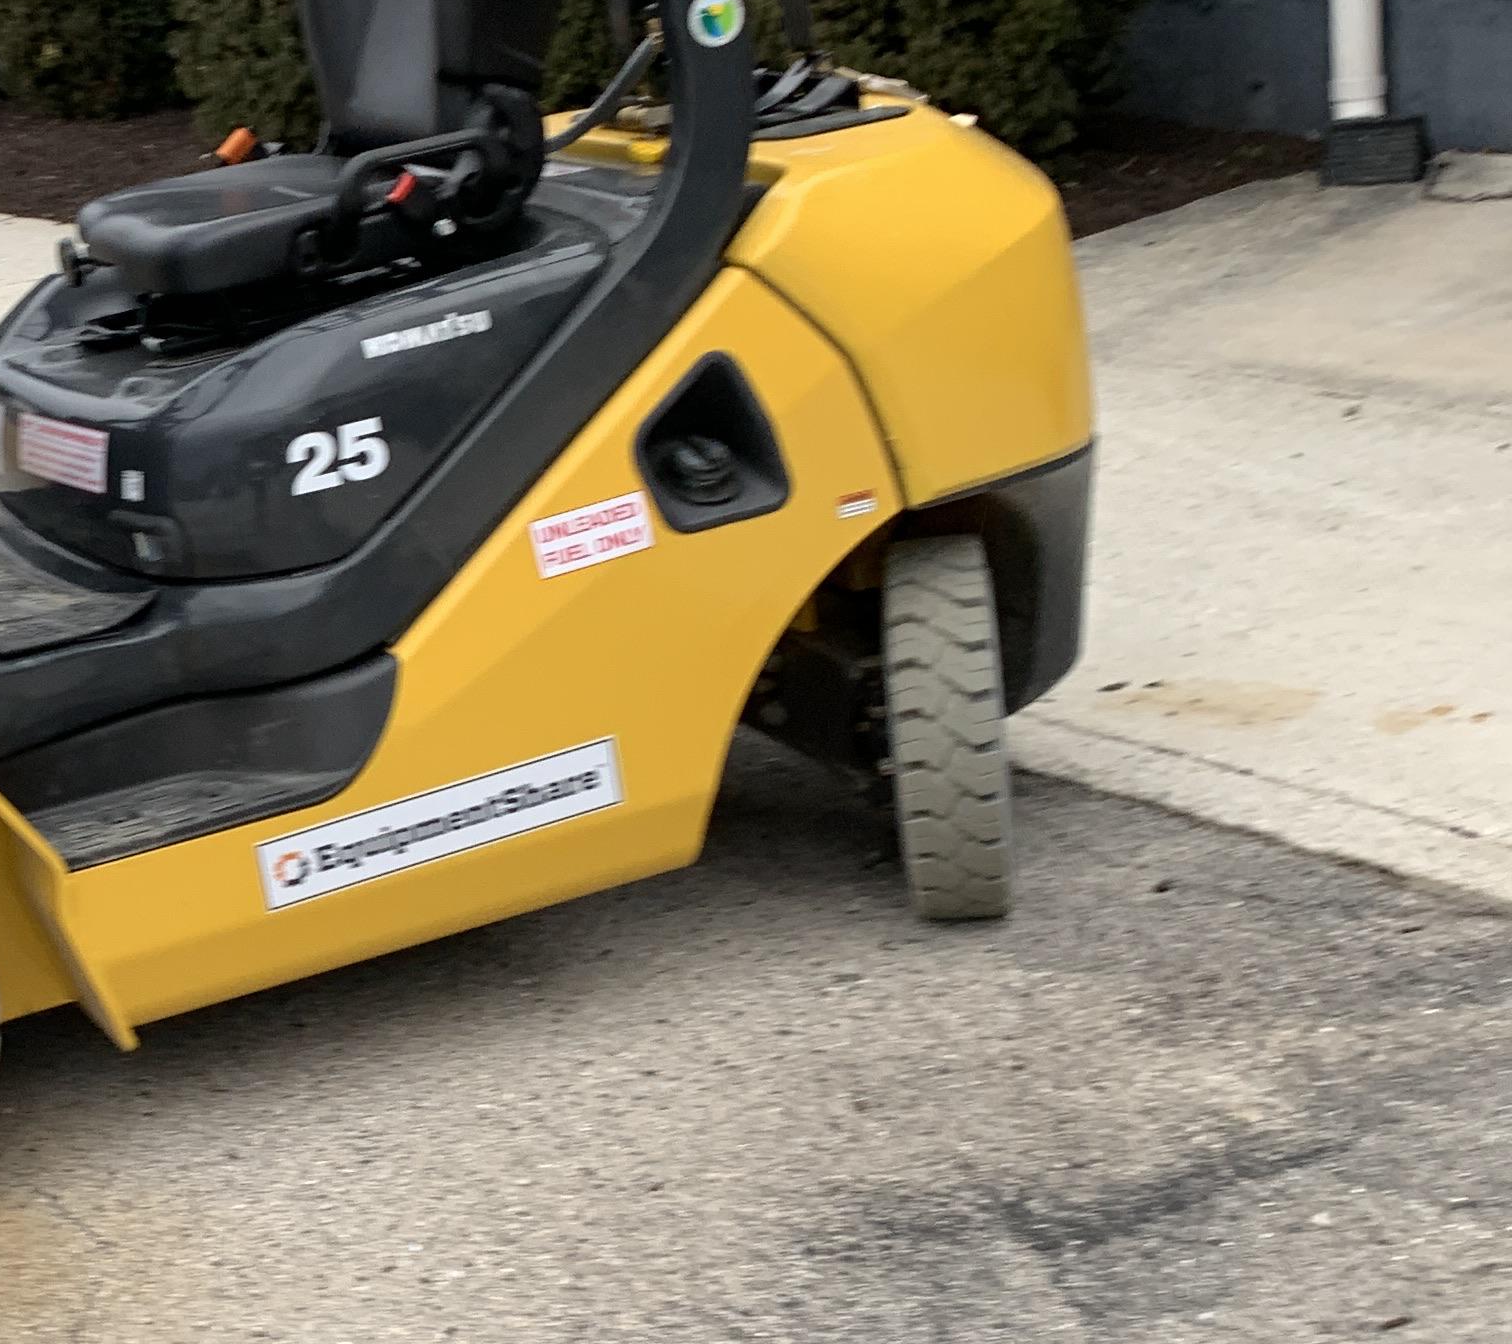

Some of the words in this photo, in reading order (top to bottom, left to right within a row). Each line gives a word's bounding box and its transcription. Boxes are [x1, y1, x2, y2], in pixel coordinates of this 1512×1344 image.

[286, 416, 391, 497] 25
[534, 502, 642, 544] UNLEADED
[542, 540, 592, 568] FUEL
[592, 523, 647, 554] ONLY
[313, 769, 601, 874] EquipmentShare
